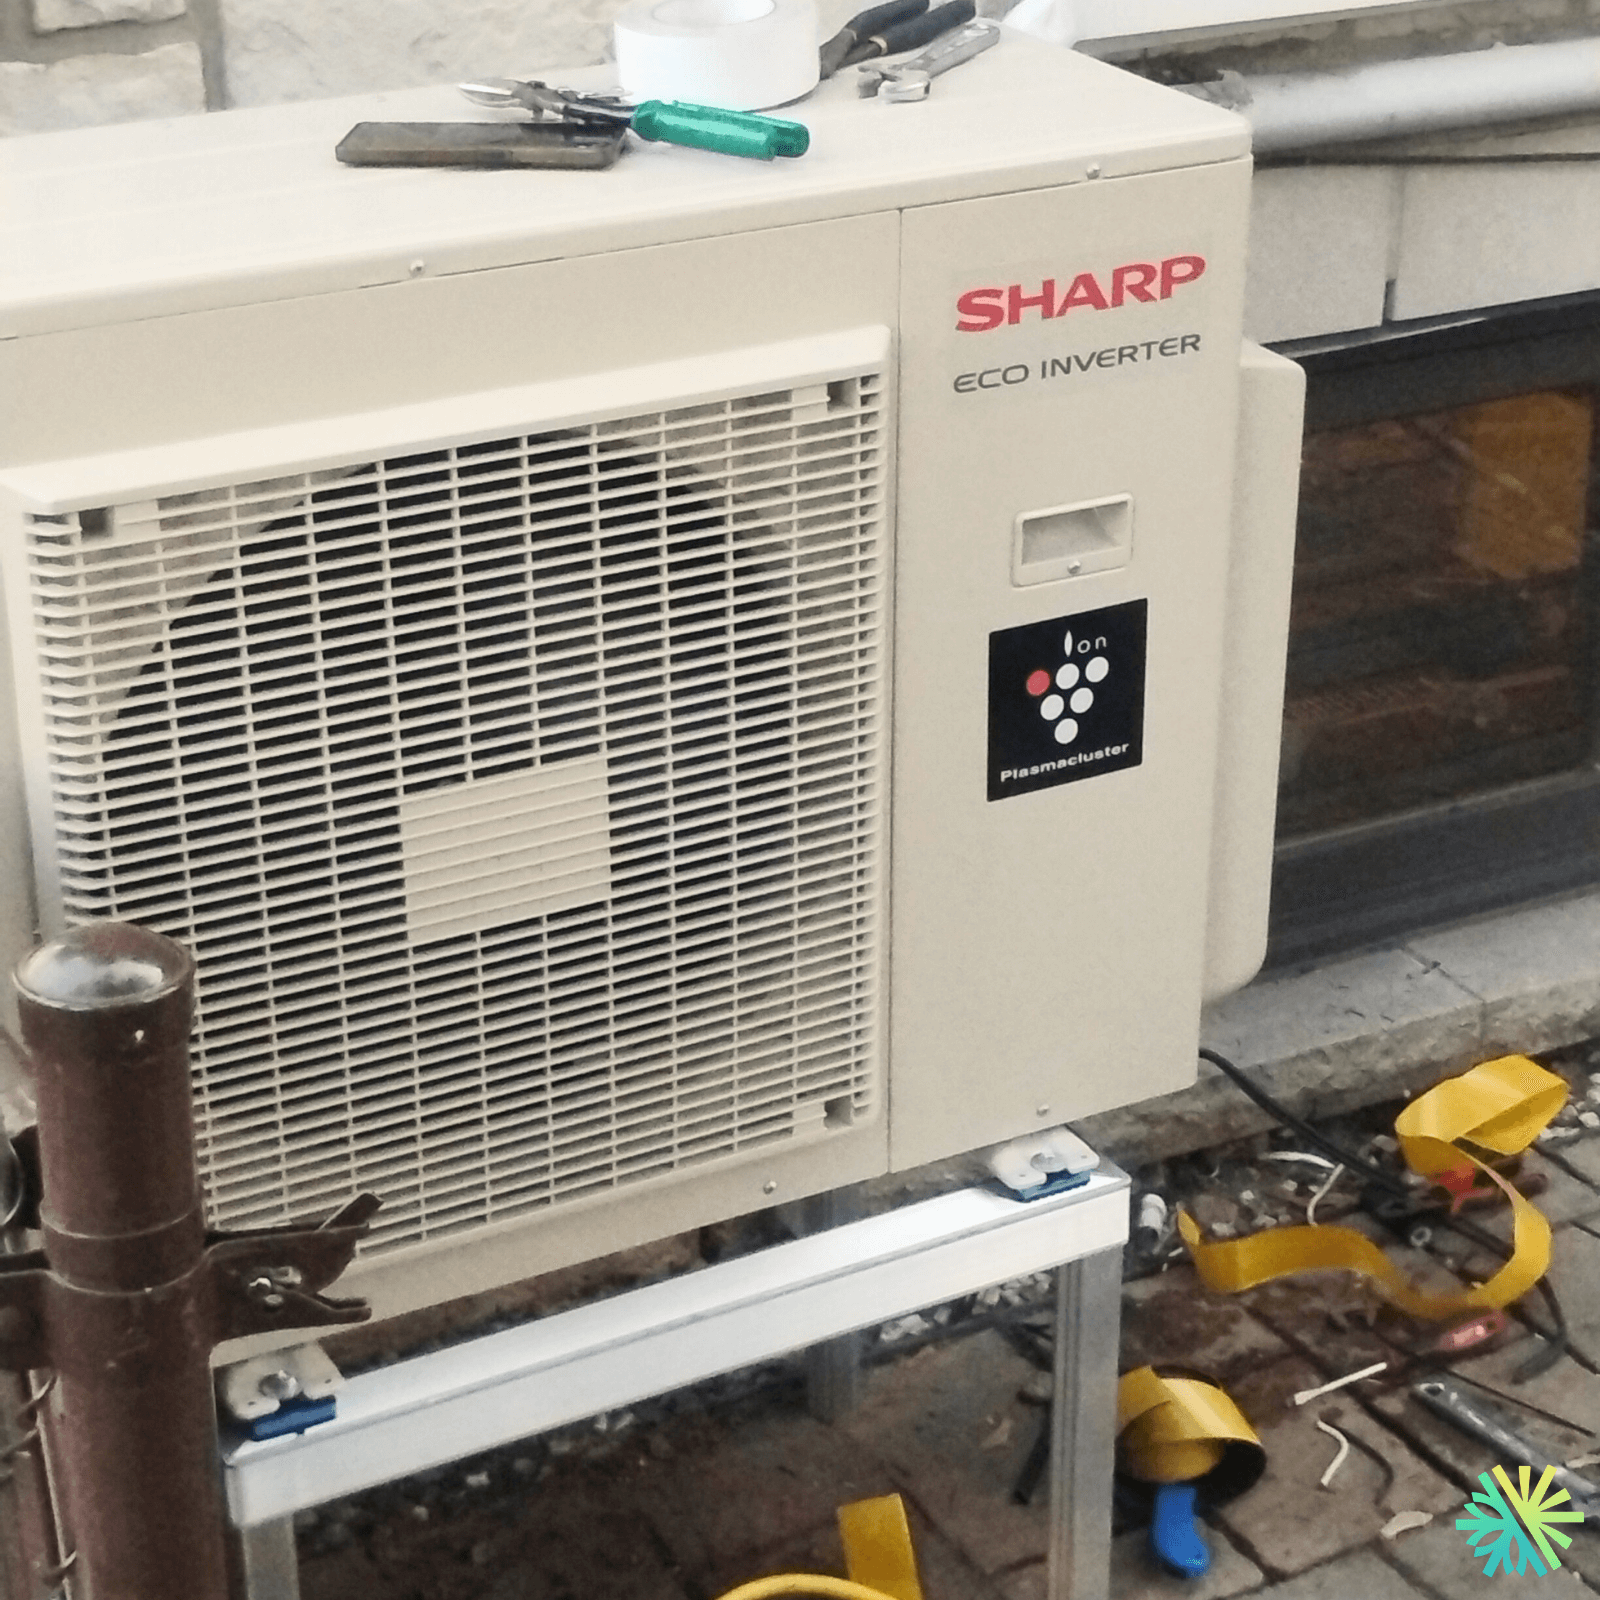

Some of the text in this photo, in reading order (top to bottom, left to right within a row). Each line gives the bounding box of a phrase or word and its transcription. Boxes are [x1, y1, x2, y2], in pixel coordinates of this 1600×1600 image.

[955, 255, 1206, 332] SHARP
[953, 333, 1201, 394] ECO INVERTER
[1000, 743, 1130, 782] Plasmacluster
